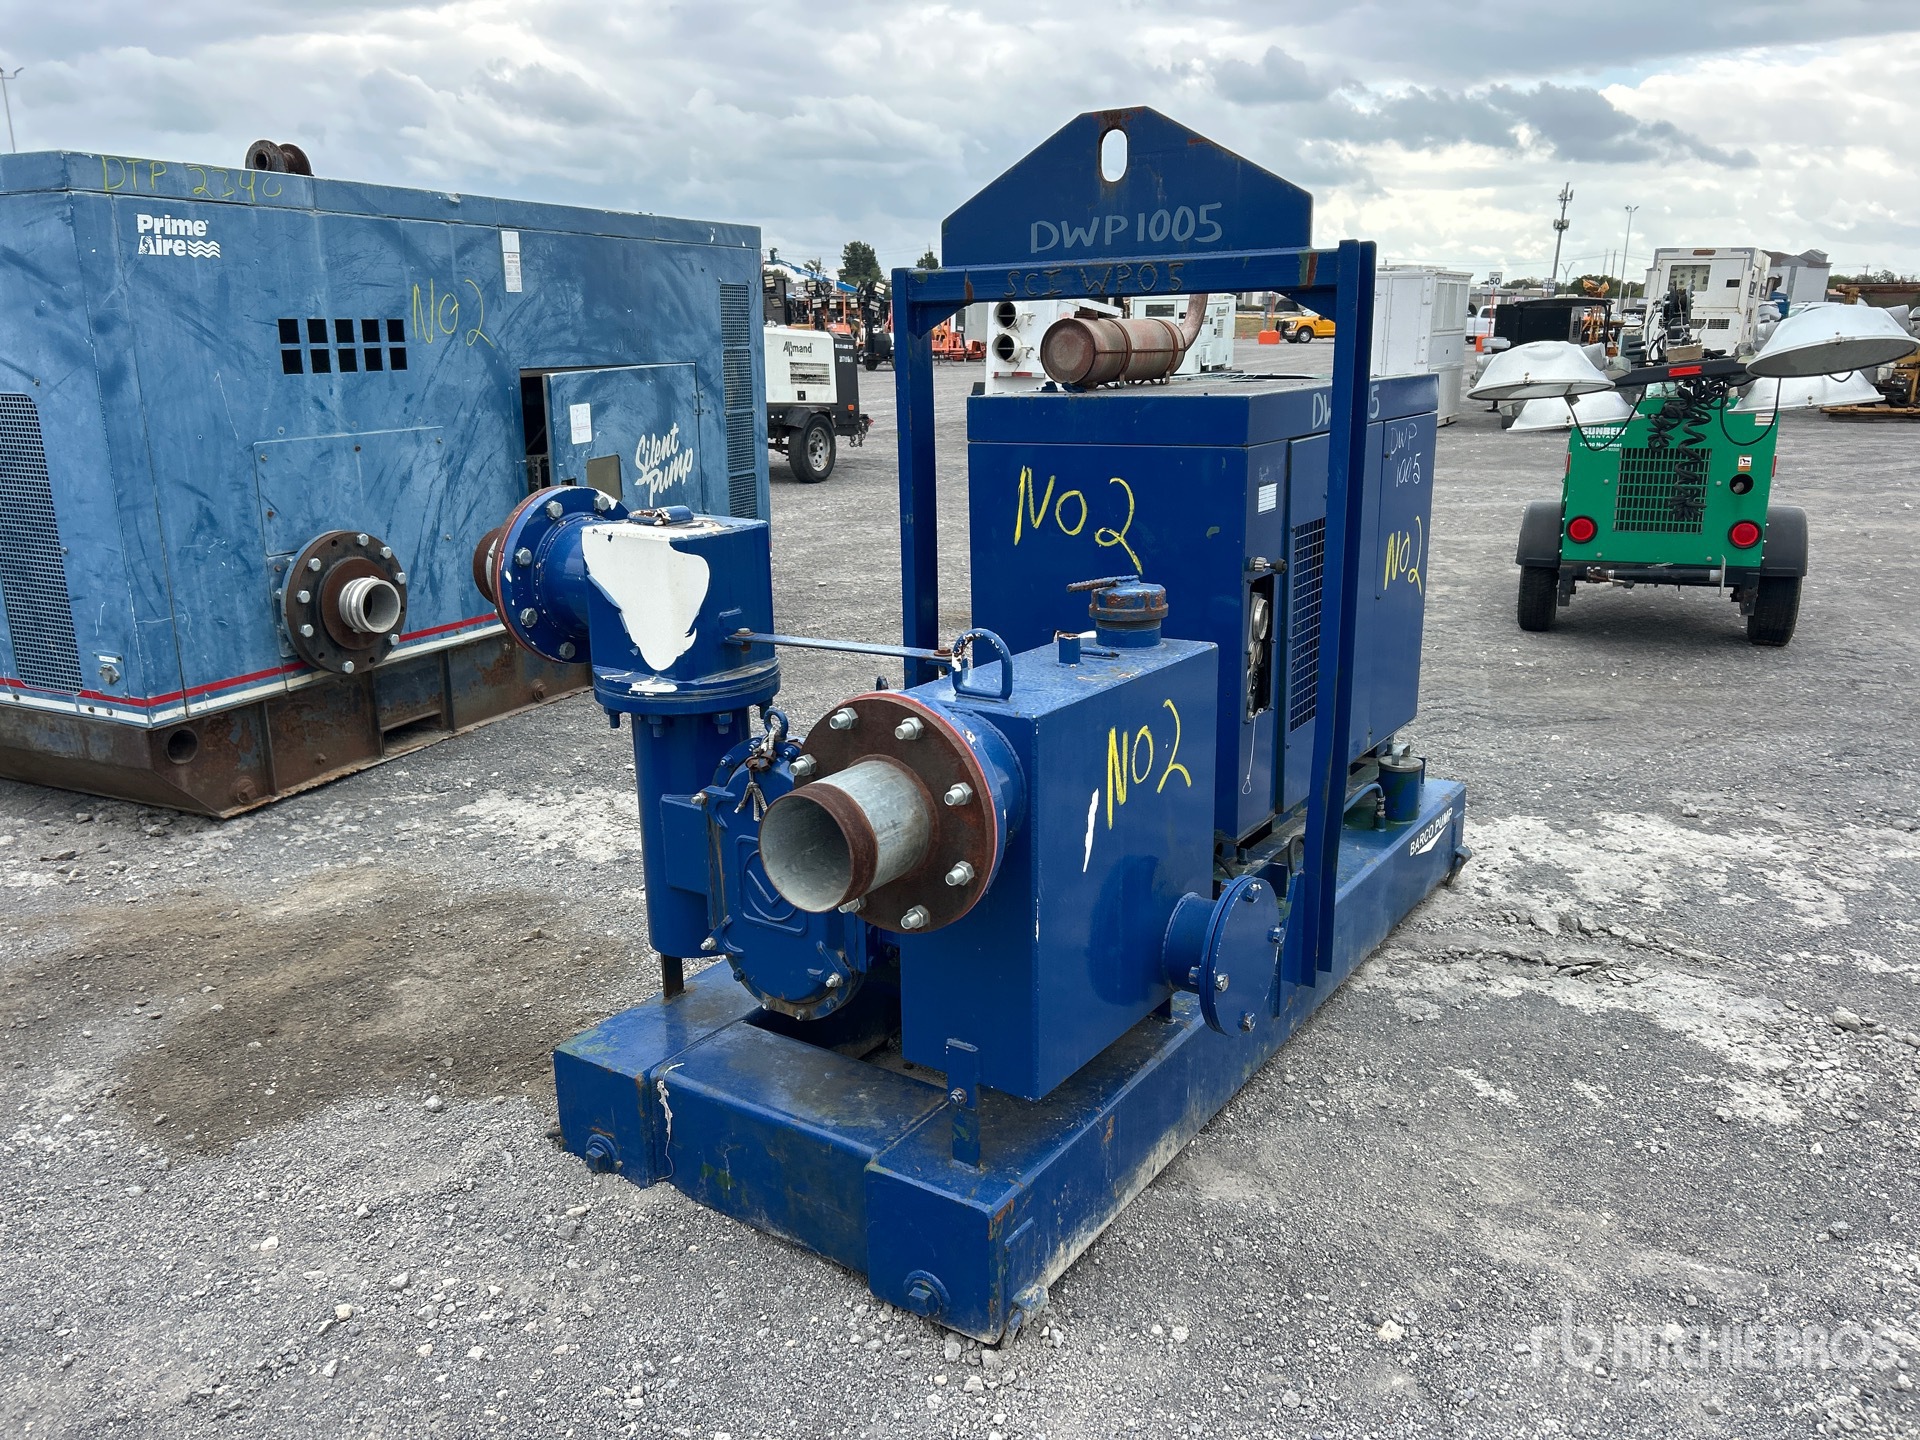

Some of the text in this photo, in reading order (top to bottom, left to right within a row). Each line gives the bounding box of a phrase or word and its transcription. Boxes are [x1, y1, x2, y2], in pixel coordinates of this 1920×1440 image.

[102, 156, 167, 192] DTP
[136, 213, 208, 237] Prime
[137, 234, 187, 256] Aire
[1489, 277, 1501, 286] 50
[634, 422, 680, 486] Silent
[648, 448, 694, 508] Pump
[1409, 806, 1453, 857] BARCO PUMP
